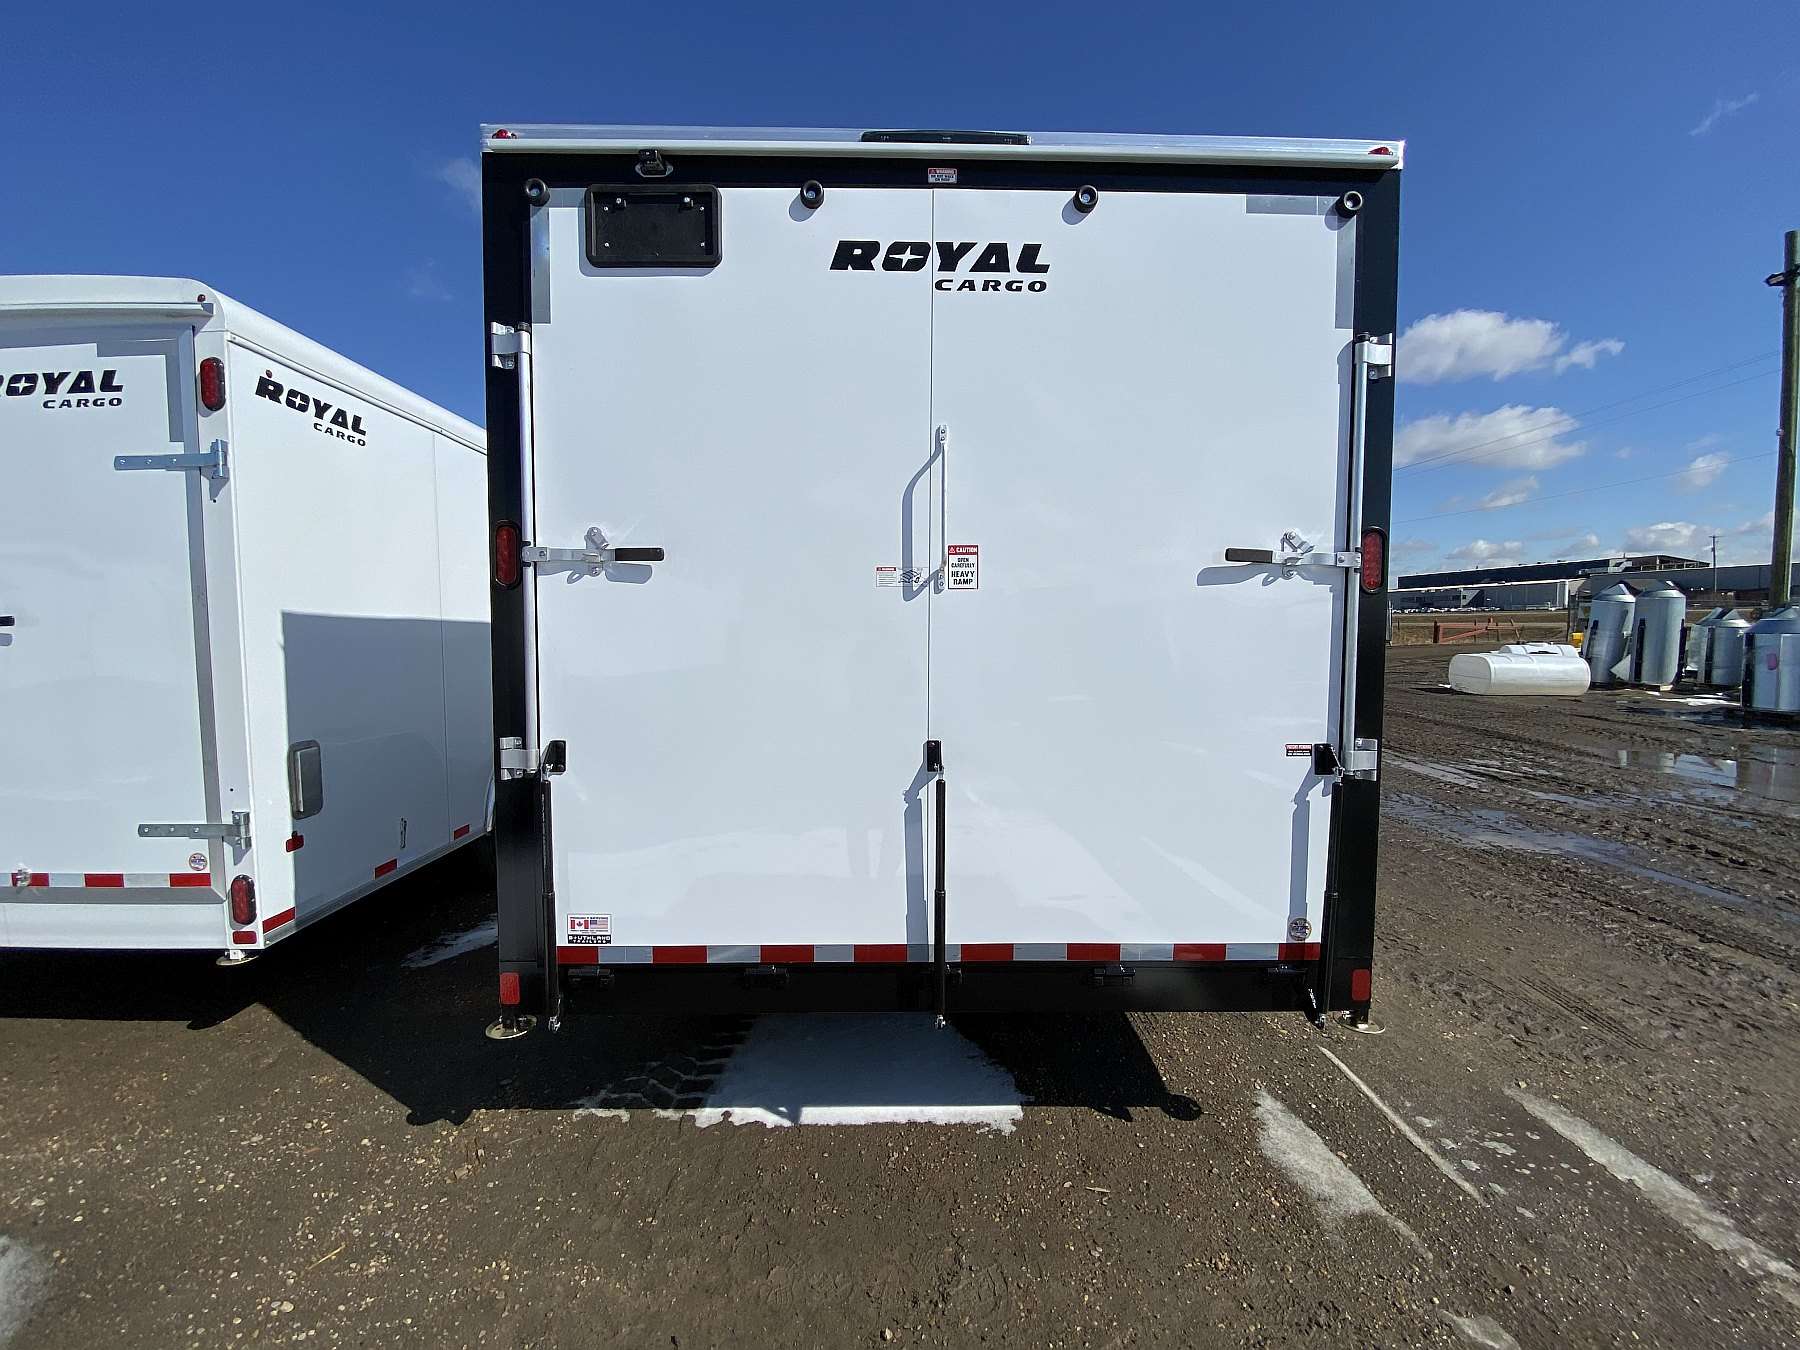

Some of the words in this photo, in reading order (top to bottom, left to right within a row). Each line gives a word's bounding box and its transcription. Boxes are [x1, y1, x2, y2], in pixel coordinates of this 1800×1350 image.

[829, 240, 1051, 274] ROYAL
[934, 278, 1048, 293] CARGO
[0, 370, 124, 397] OYAL
[42, 397, 123, 409] CARGO
[255, 375, 367, 436] ROYAL
[313, 422, 366, 447] CARGO
[951, 570, 975, 578] HEAVY
[953, 578, 973, 586] RAMP
